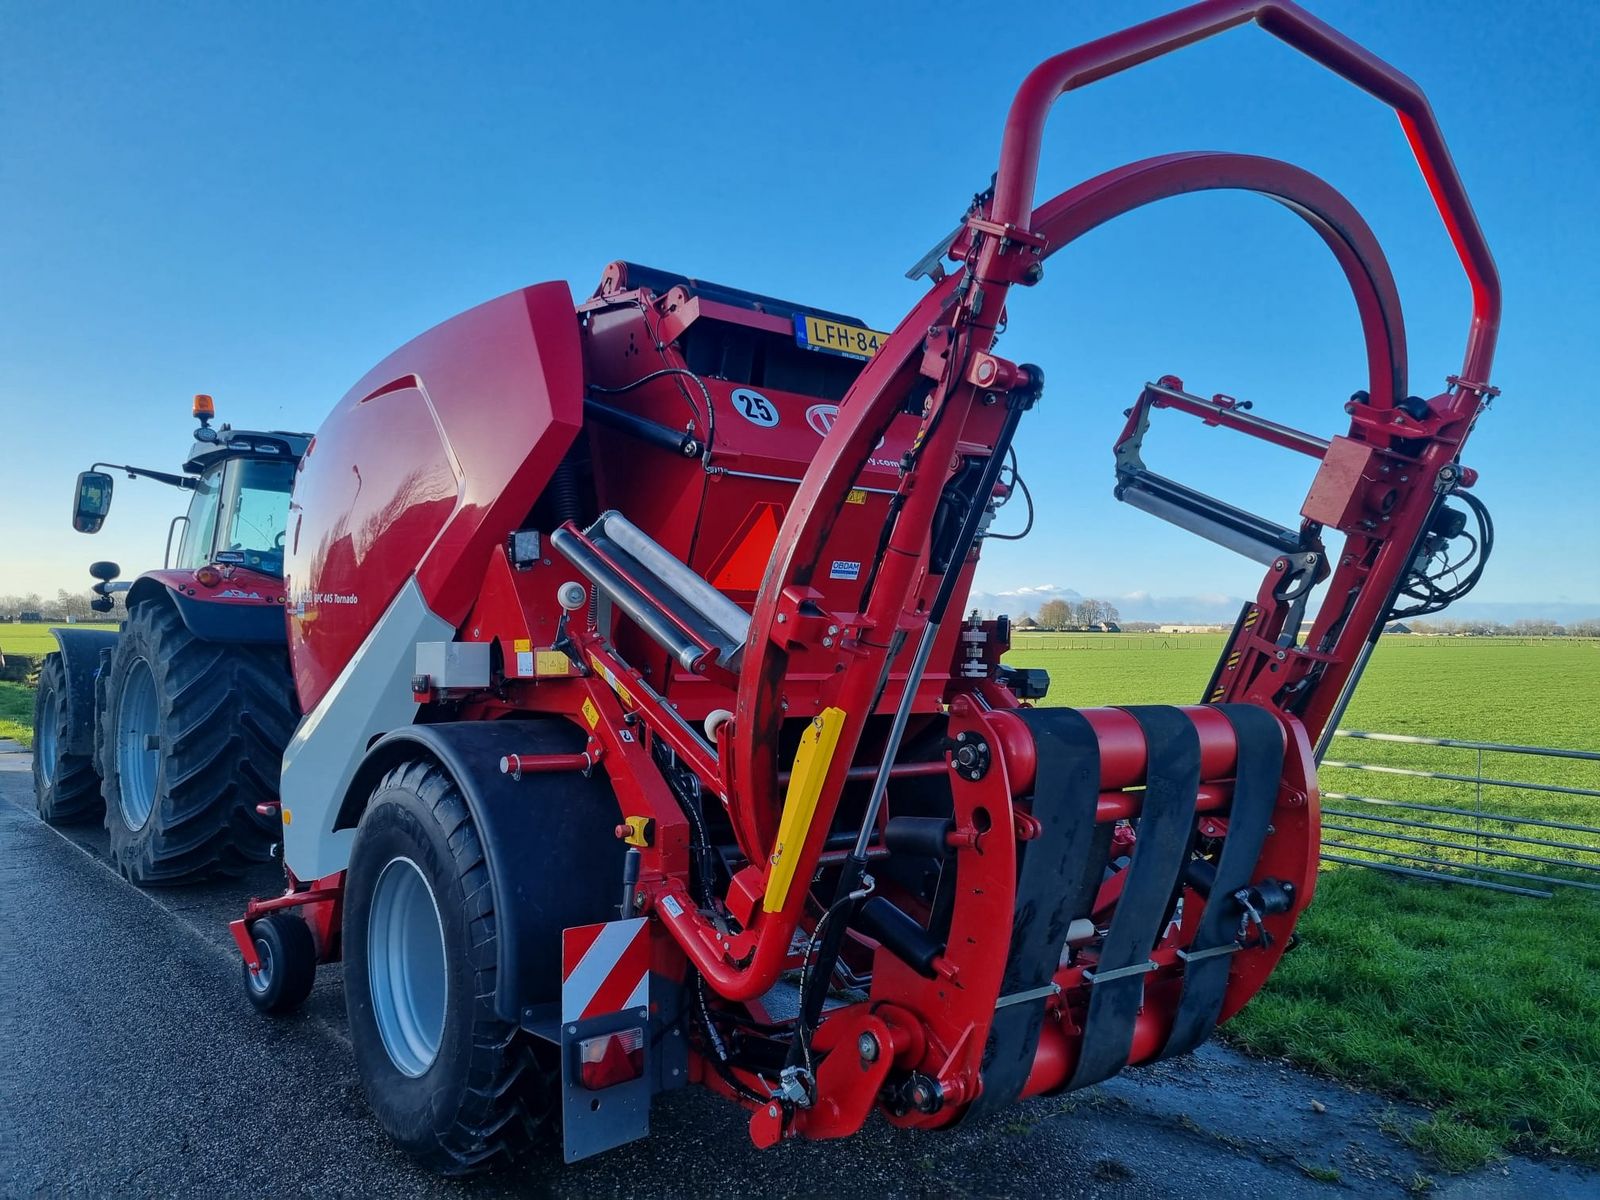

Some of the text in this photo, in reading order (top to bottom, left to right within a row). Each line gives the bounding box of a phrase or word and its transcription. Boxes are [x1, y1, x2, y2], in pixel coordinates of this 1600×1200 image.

[813, 322, 884, 353] LFH-84-
[739, 394, 773, 422] 25
[832, 561, 860, 570] OBDAM
[323, 593, 333, 604] 445
[334, 592, 359, 604] Tornado
